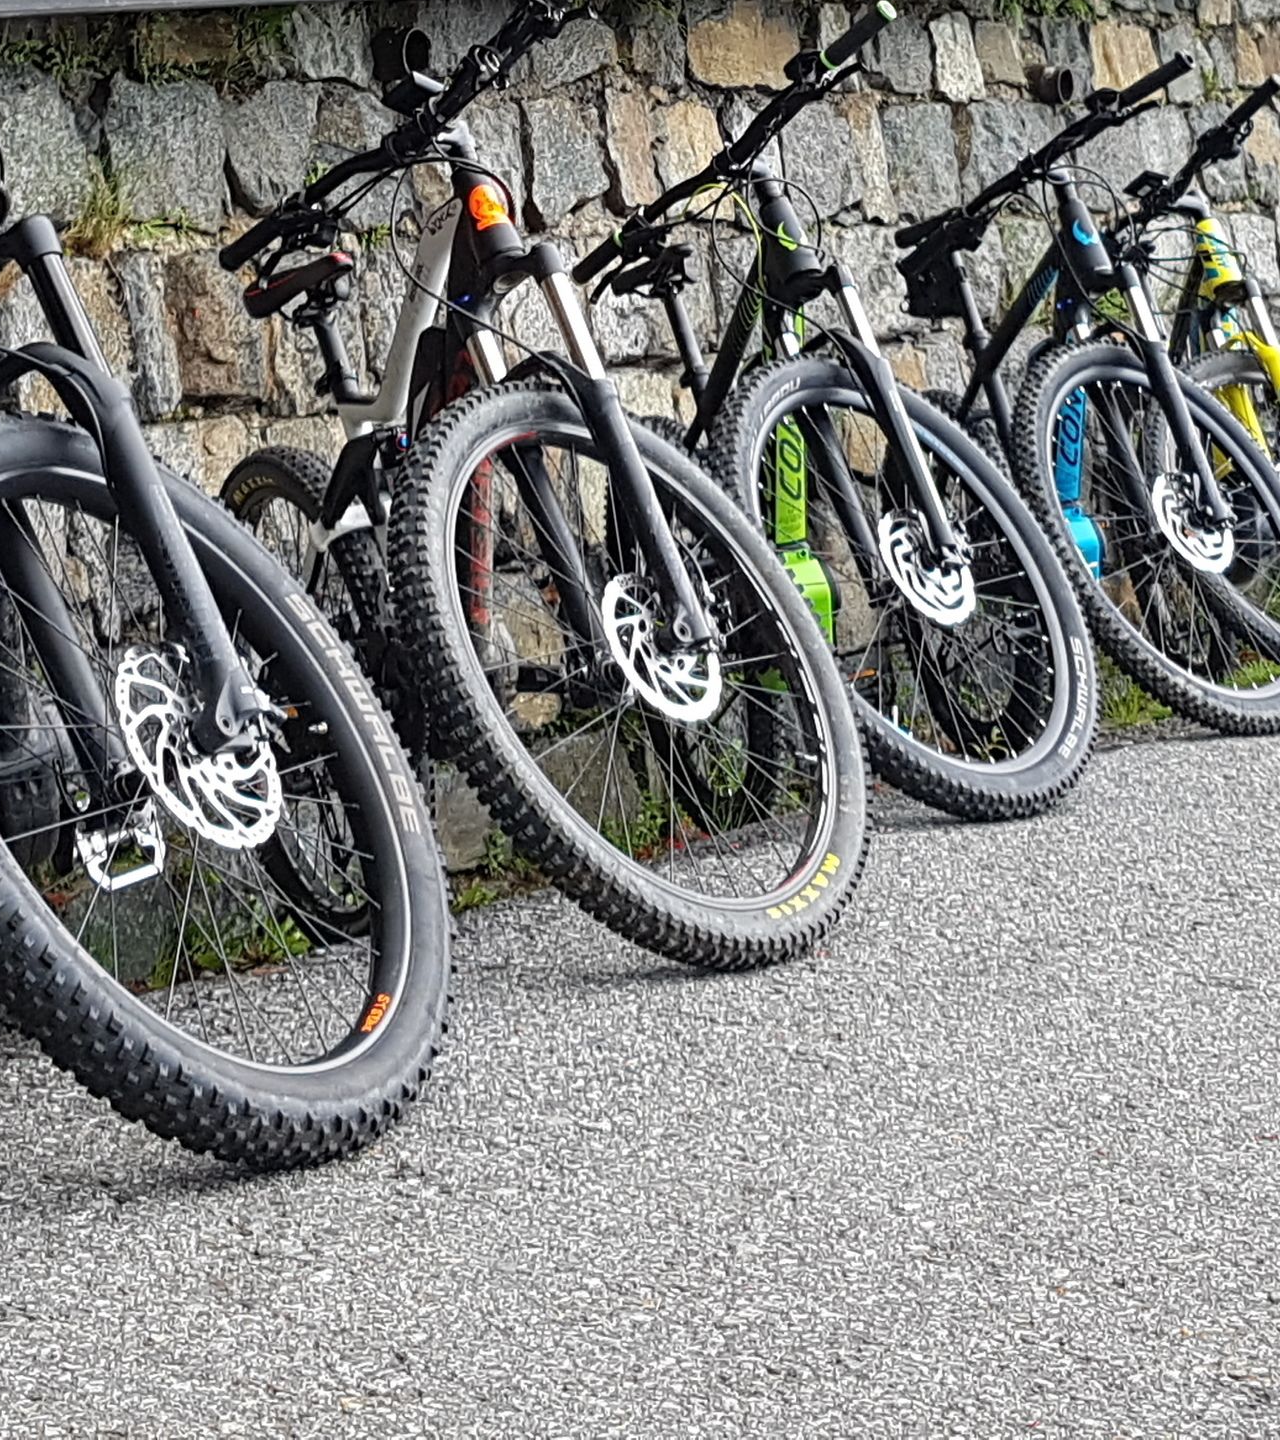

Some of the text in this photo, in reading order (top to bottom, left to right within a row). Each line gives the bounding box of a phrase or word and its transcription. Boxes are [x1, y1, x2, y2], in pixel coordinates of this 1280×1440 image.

[284, 592, 422, 834] SCHWALBE
[1057, 635, 1089, 759] SCHWALBE
[765, 851, 841, 920] MAXXIS
